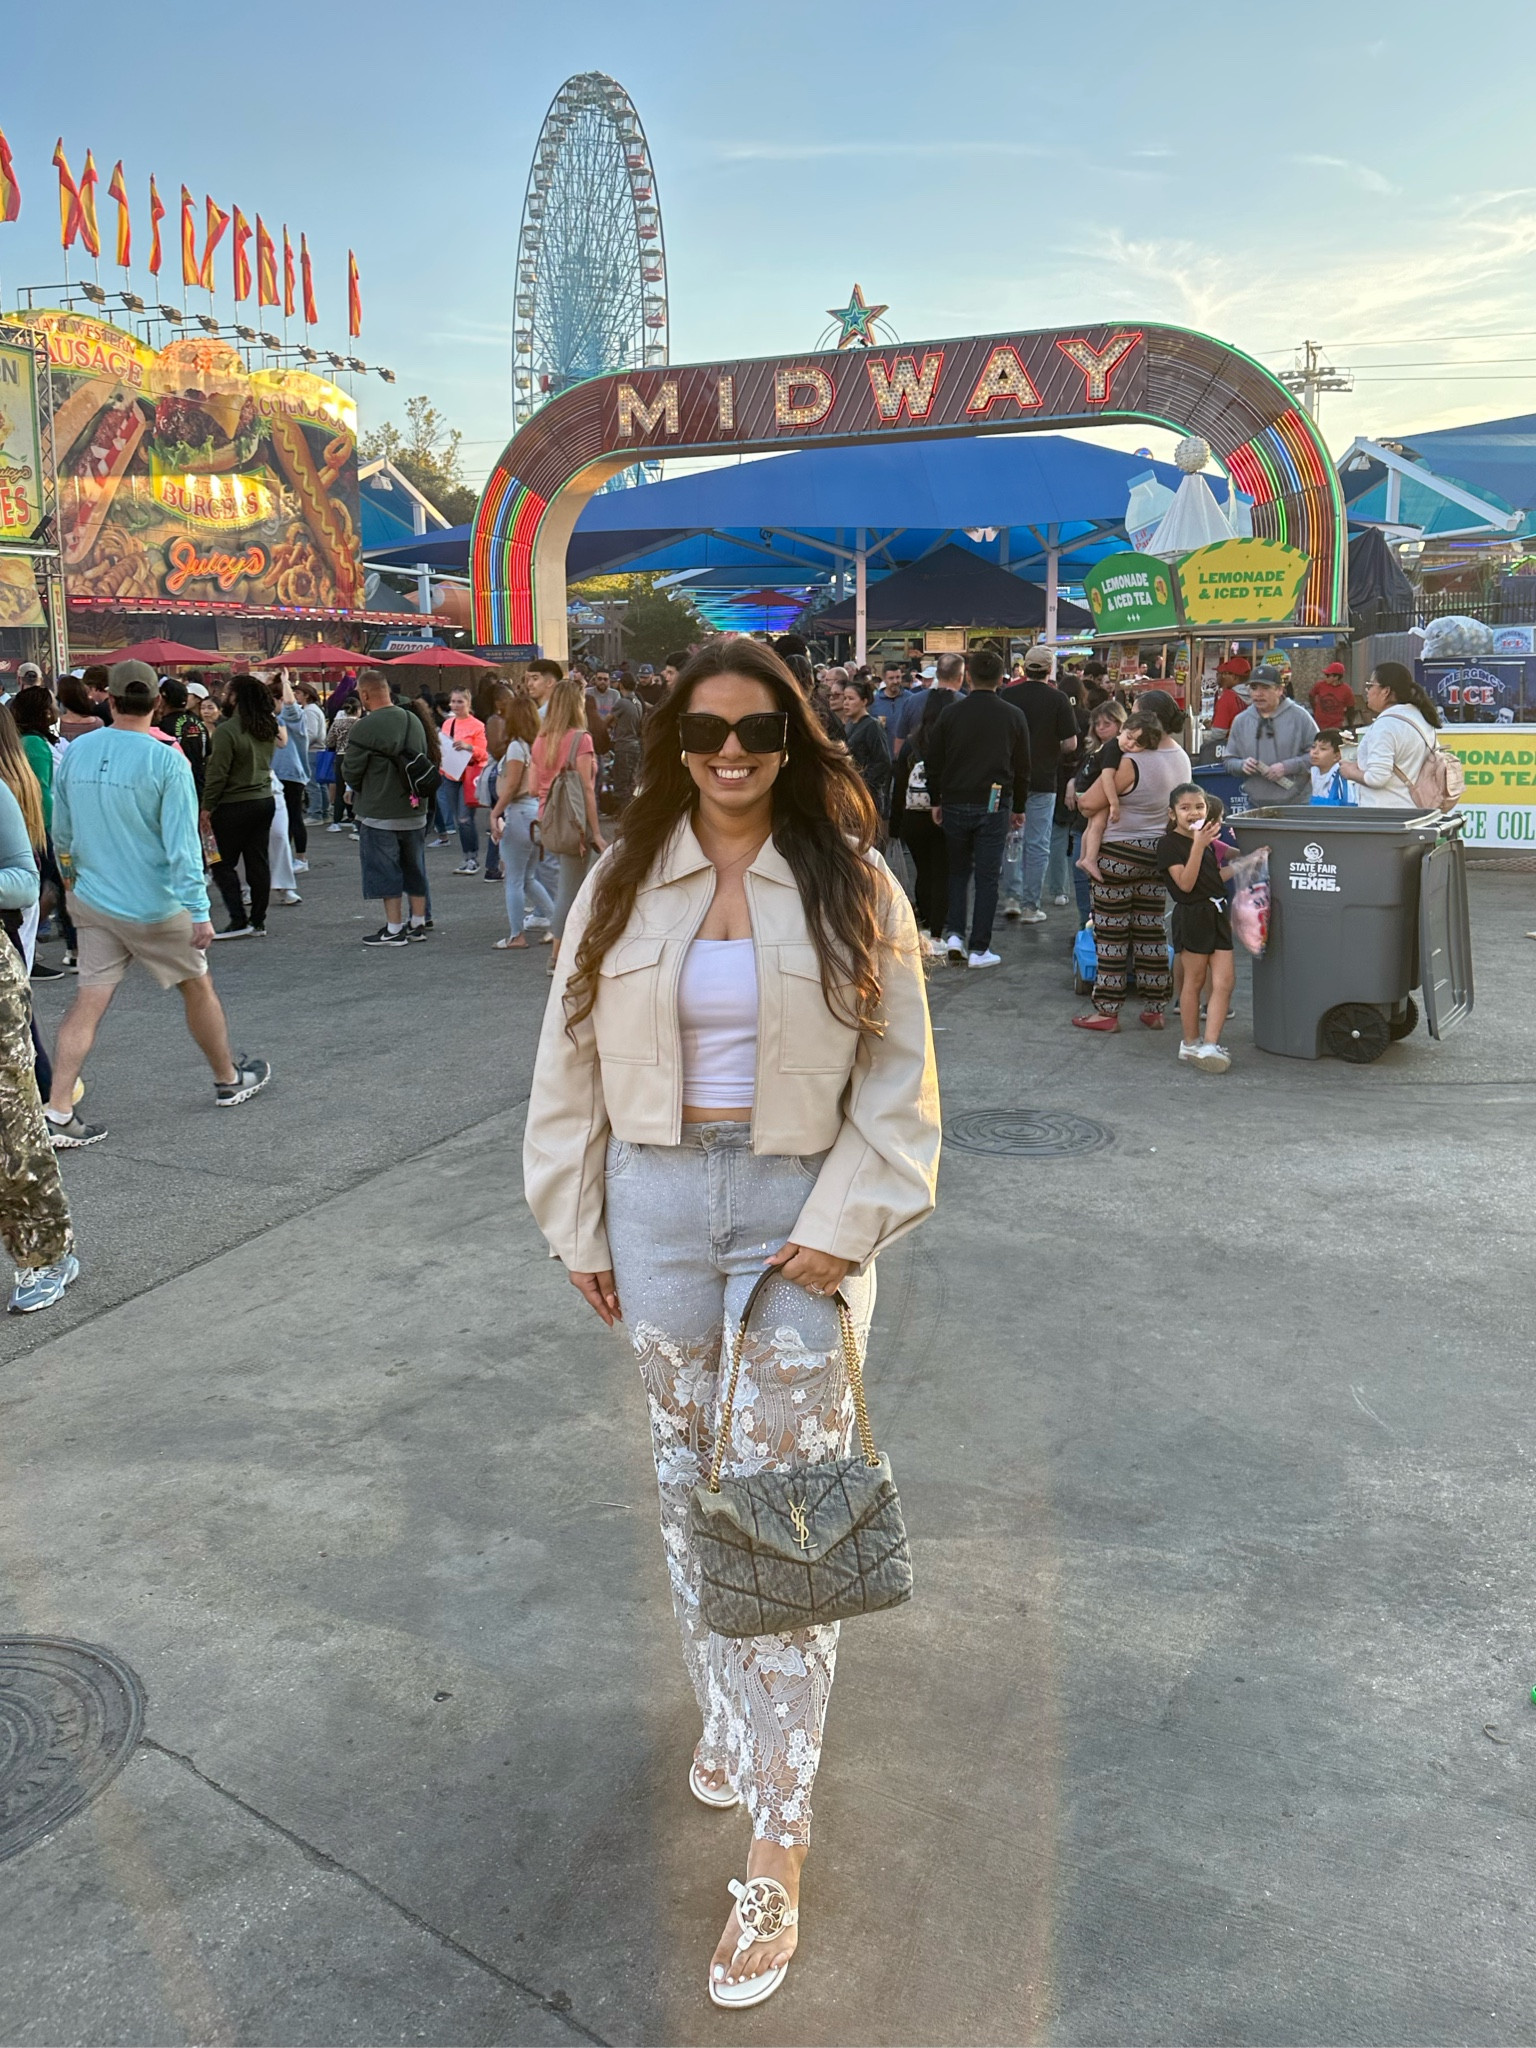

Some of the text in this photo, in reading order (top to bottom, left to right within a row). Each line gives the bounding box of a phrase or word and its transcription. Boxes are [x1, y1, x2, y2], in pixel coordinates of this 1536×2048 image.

[72, 320, 137, 354] WESTERN
[36, 335, 143, 388] AUSAGE
[617, 332, 1142, 437] MIDWAY
[0, 486, 30, 526] ES
[162, 481, 259, 520] BURGES
[165, 536, 266, 593] Juicys
[1100, 572, 1150, 595] LEMONADE
[1199, 570, 1286, 585] LEMONADE
[1107, 590, 1153, 612] & ICED TEA
[1199, 585, 1283, 599] & ICED TEA
[54, 590, 66, 671] TURKEY
[1437, 668, 1506, 693] EMERGENCY
[1448, 685, 1496, 705] ICE
[1447, 751, 1536, 765] MONAD
[1464, 771, 1495, 785] ED
[1497, 811, 1536, 840] COL
[1289, 862, 1337, 874] STATE FAIR
